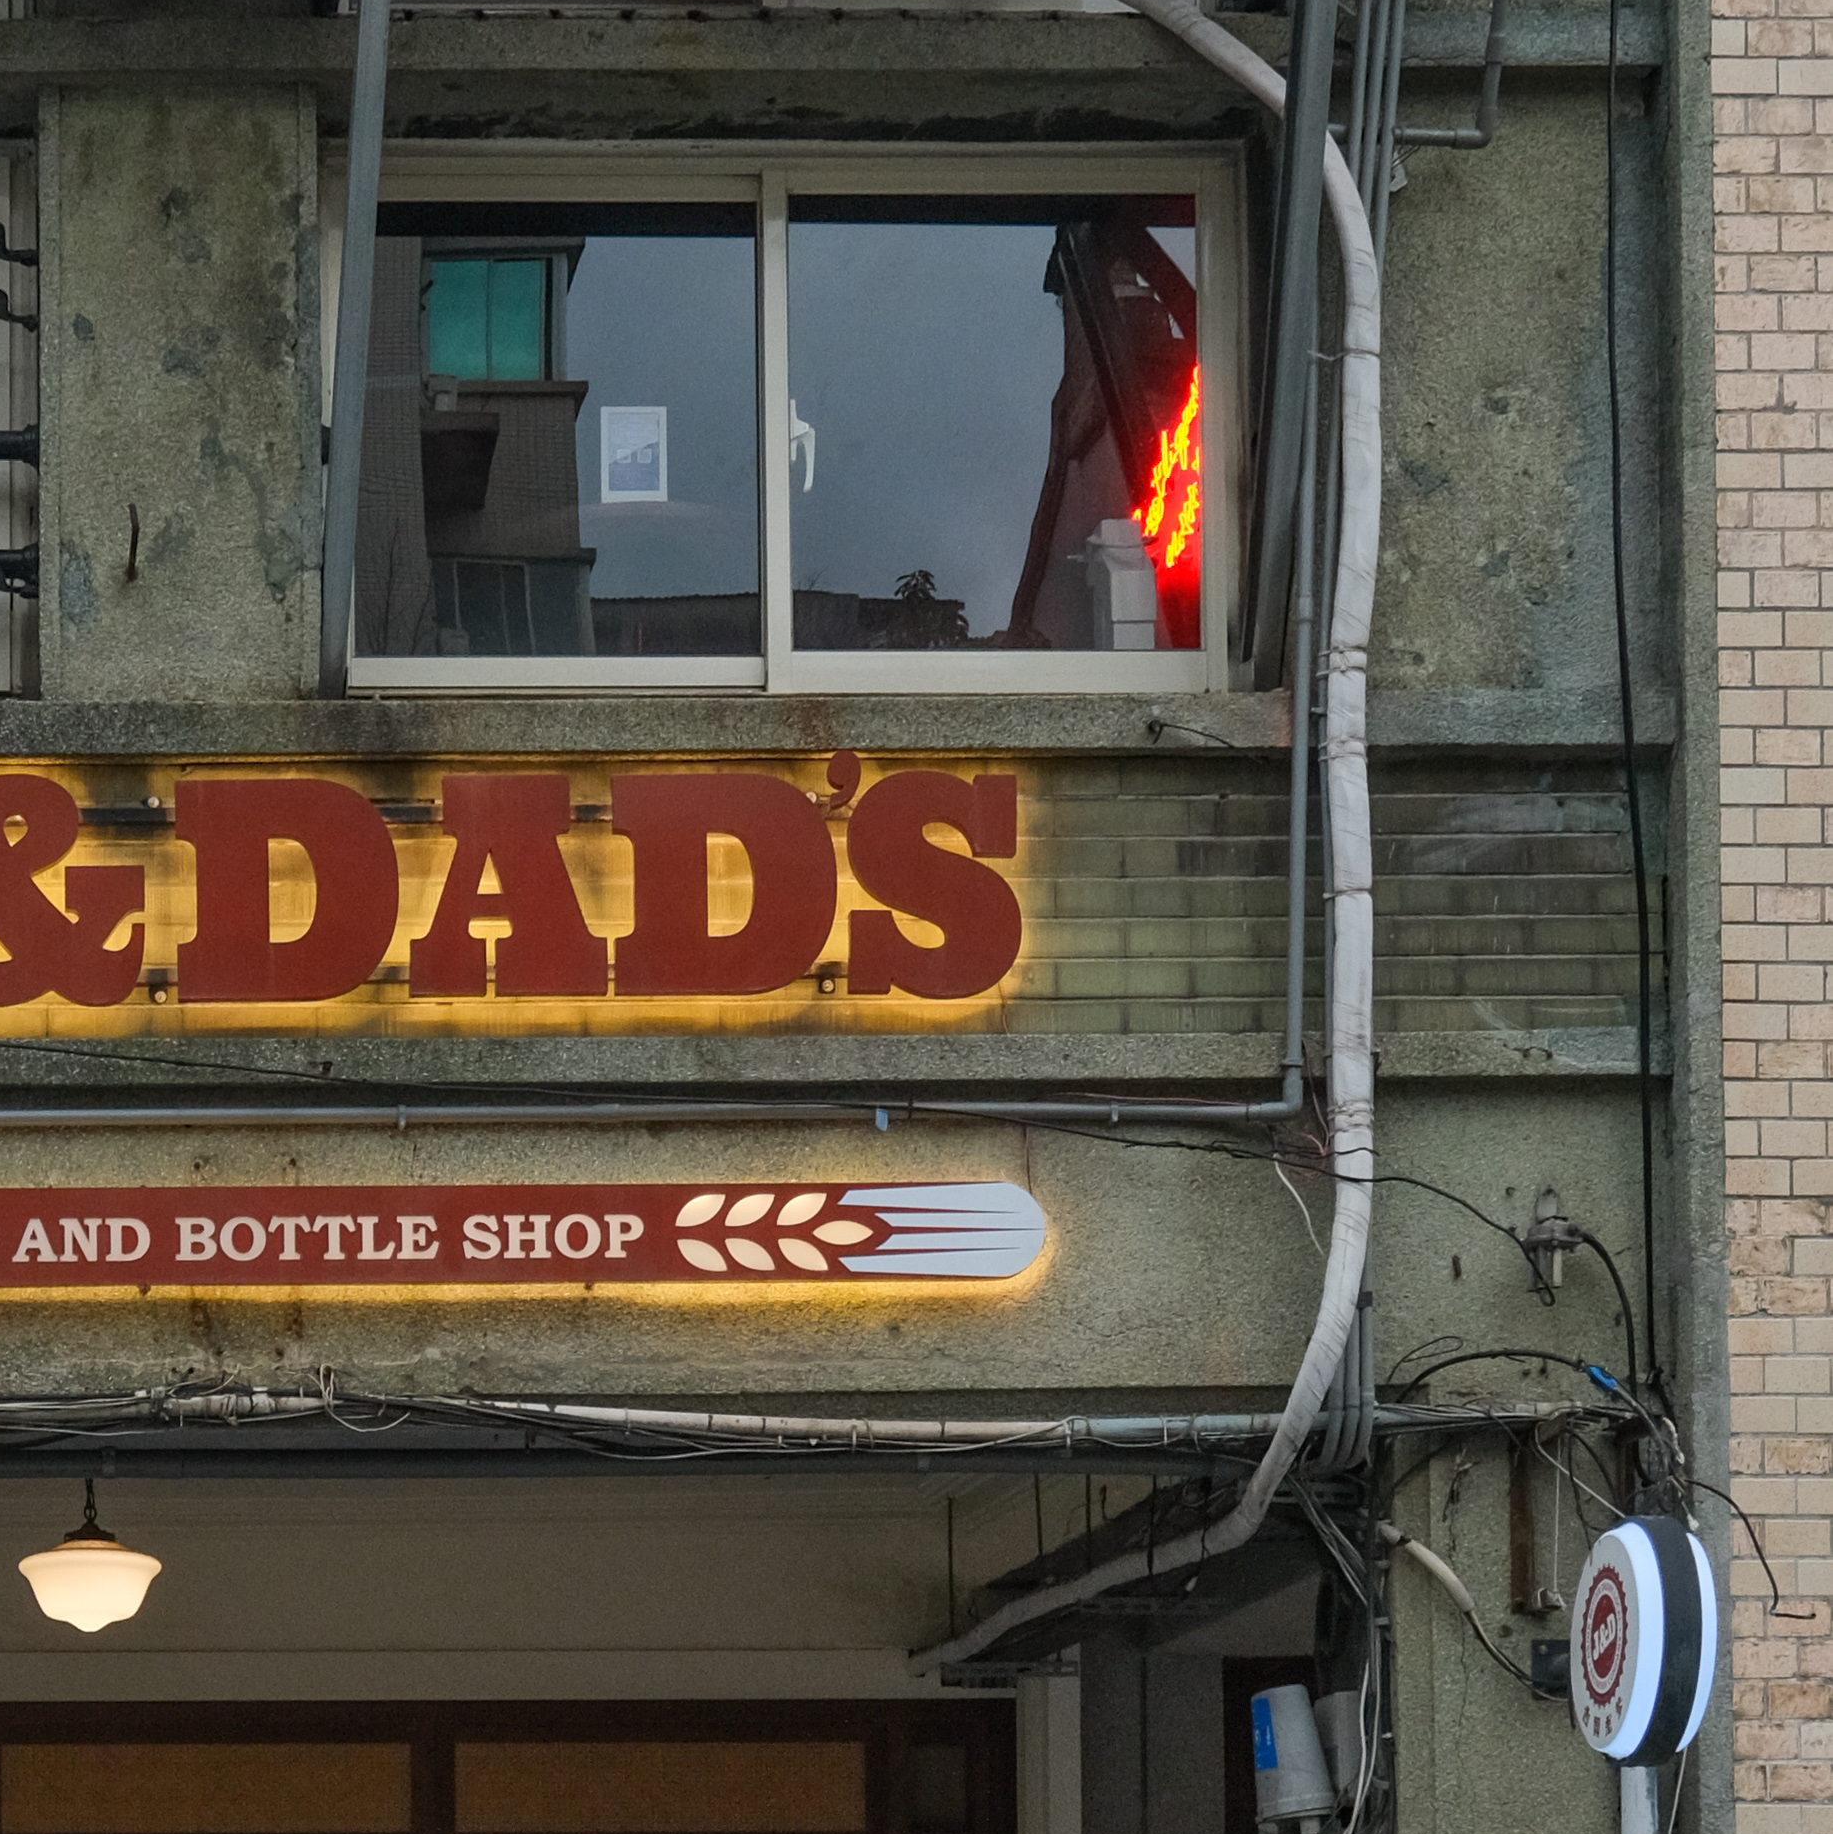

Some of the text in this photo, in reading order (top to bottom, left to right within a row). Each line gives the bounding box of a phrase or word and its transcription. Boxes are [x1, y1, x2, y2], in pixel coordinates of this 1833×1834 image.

[11, 1217, 152, 1263] AND
[174, 1214, 441, 1262] BOTTLE
[462, 1212, 645, 1260] SHOP
